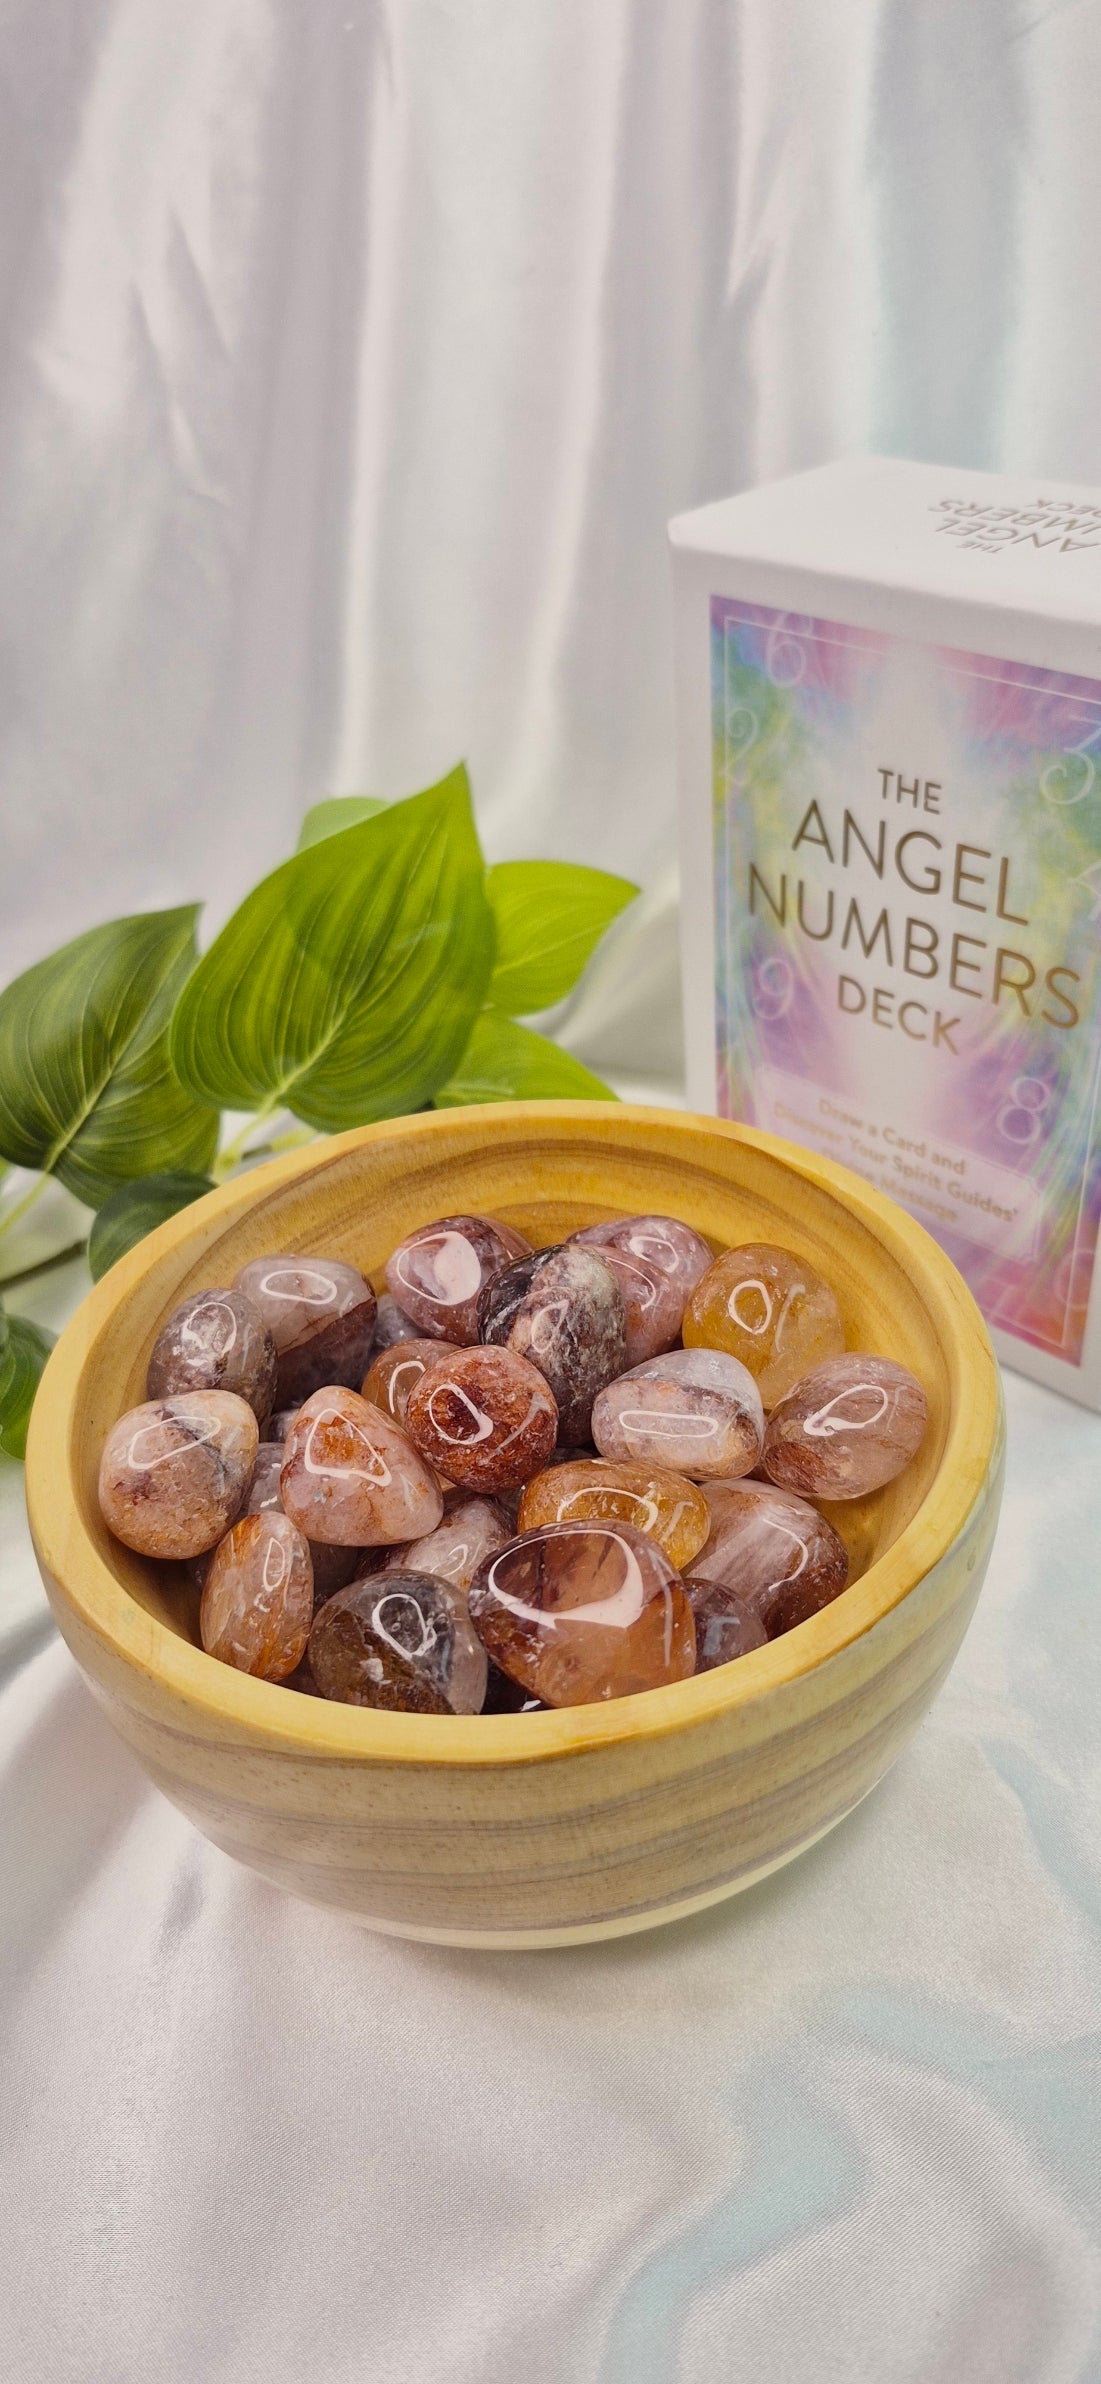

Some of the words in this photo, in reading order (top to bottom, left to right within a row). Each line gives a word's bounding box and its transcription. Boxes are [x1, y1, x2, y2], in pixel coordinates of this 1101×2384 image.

[935, 518, 1101, 552] ANGEL
[957, 540, 1004, 553] THE
[877, 768, 942, 815] THE
[791, 799, 1029, 927] ANGEL
[748, 862, 1081, 1030] NUMBERS
[837, 975, 961, 1055] DECK
[819, 1097, 864, 1131] Draw
[868, 1125, 878, 1138] a
[882, 1127, 926, 1159] Card
[931, 1152, 966, 1176] and
[848, 1136, 887, 1165] Your
[892, 1155, 941, 1192] Spirit
[946, 1180, 1018, 1222] Guides'
